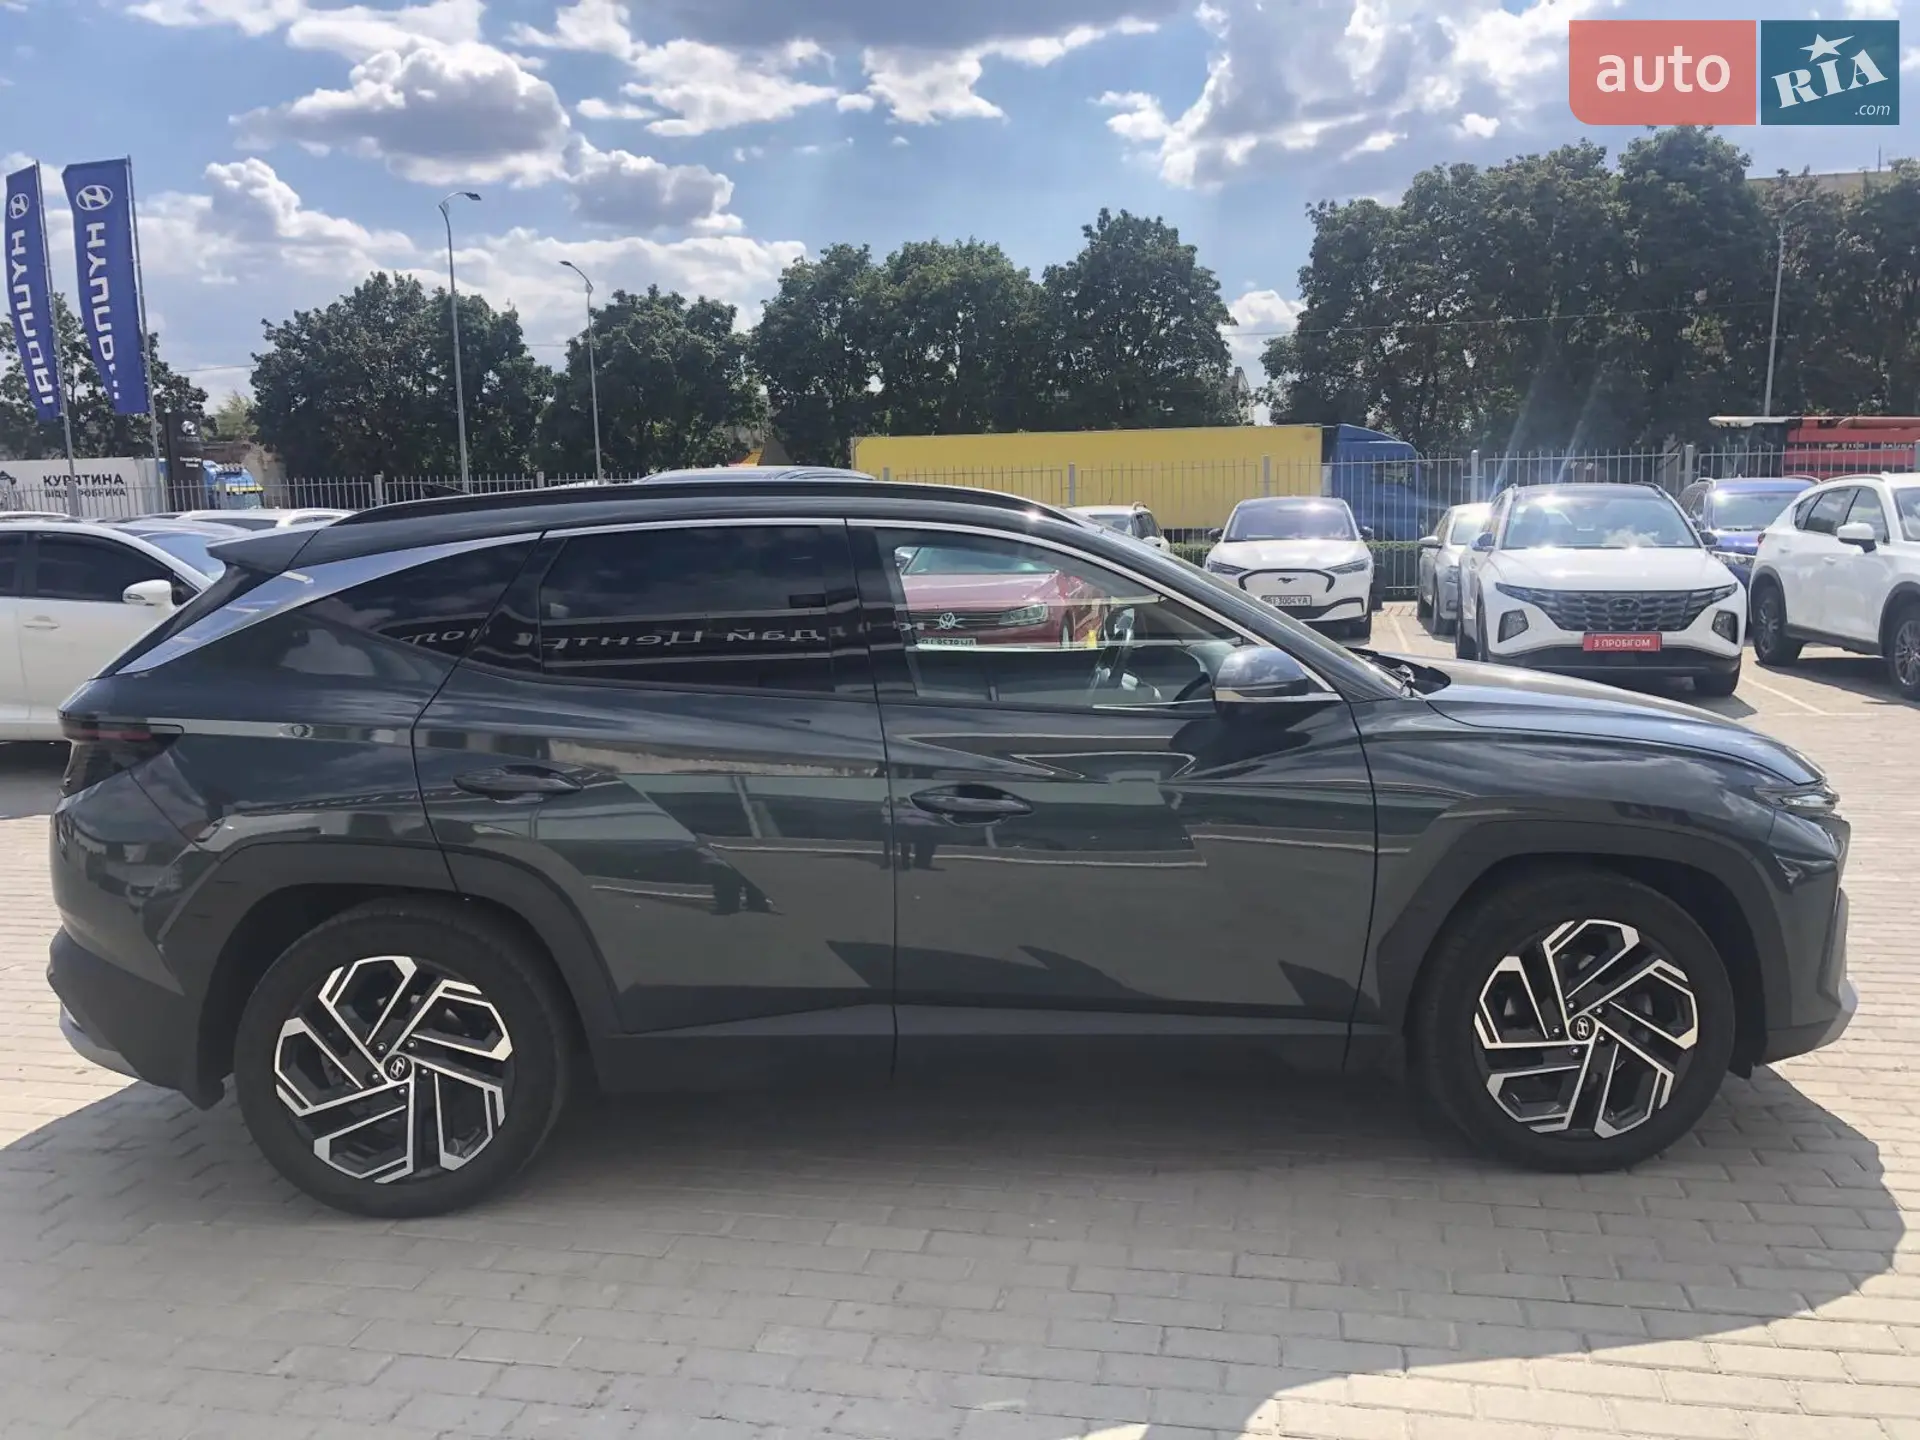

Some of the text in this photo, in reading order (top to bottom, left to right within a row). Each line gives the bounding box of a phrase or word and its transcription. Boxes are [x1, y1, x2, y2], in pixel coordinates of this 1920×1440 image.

[86, 222, 119, 400] HYUND
[43, 474, 124, 486] КУРЯТИНА
[1601, 638, 1651, 648] ПРОБІГОМ
